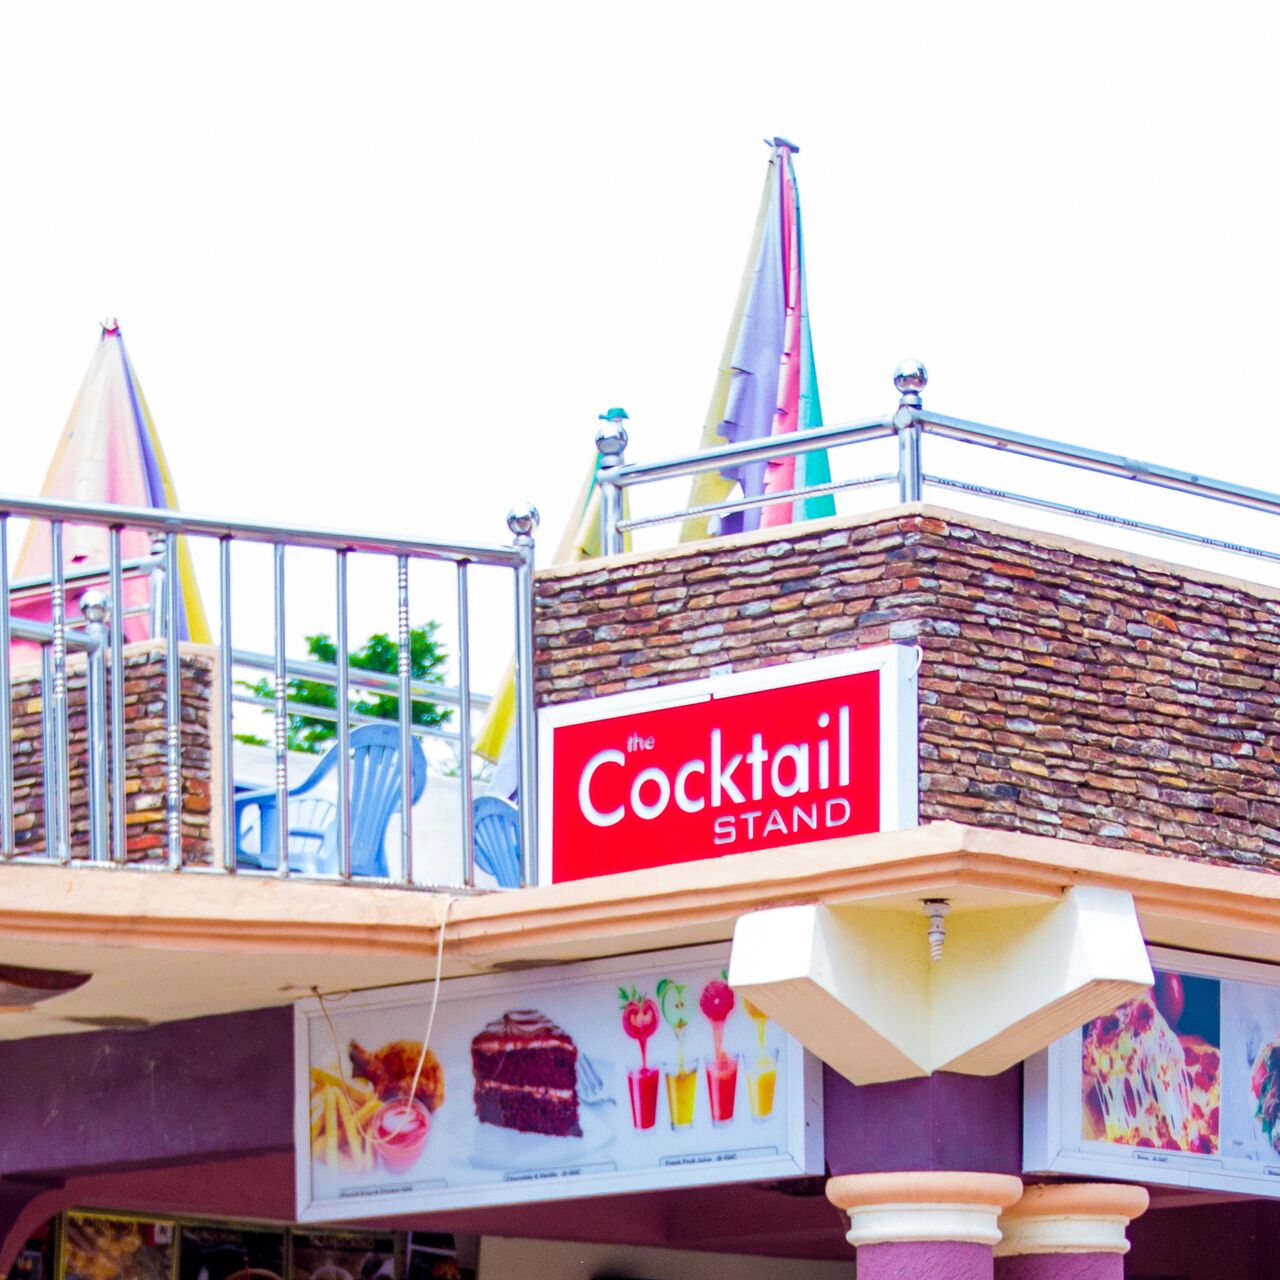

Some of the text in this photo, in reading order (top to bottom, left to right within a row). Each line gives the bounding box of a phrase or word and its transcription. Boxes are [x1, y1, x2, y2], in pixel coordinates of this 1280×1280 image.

[578, 704, 851, 827] Cocktail
[626, 731, 655, 753] the
[712, 797, 851, 845] STAND
